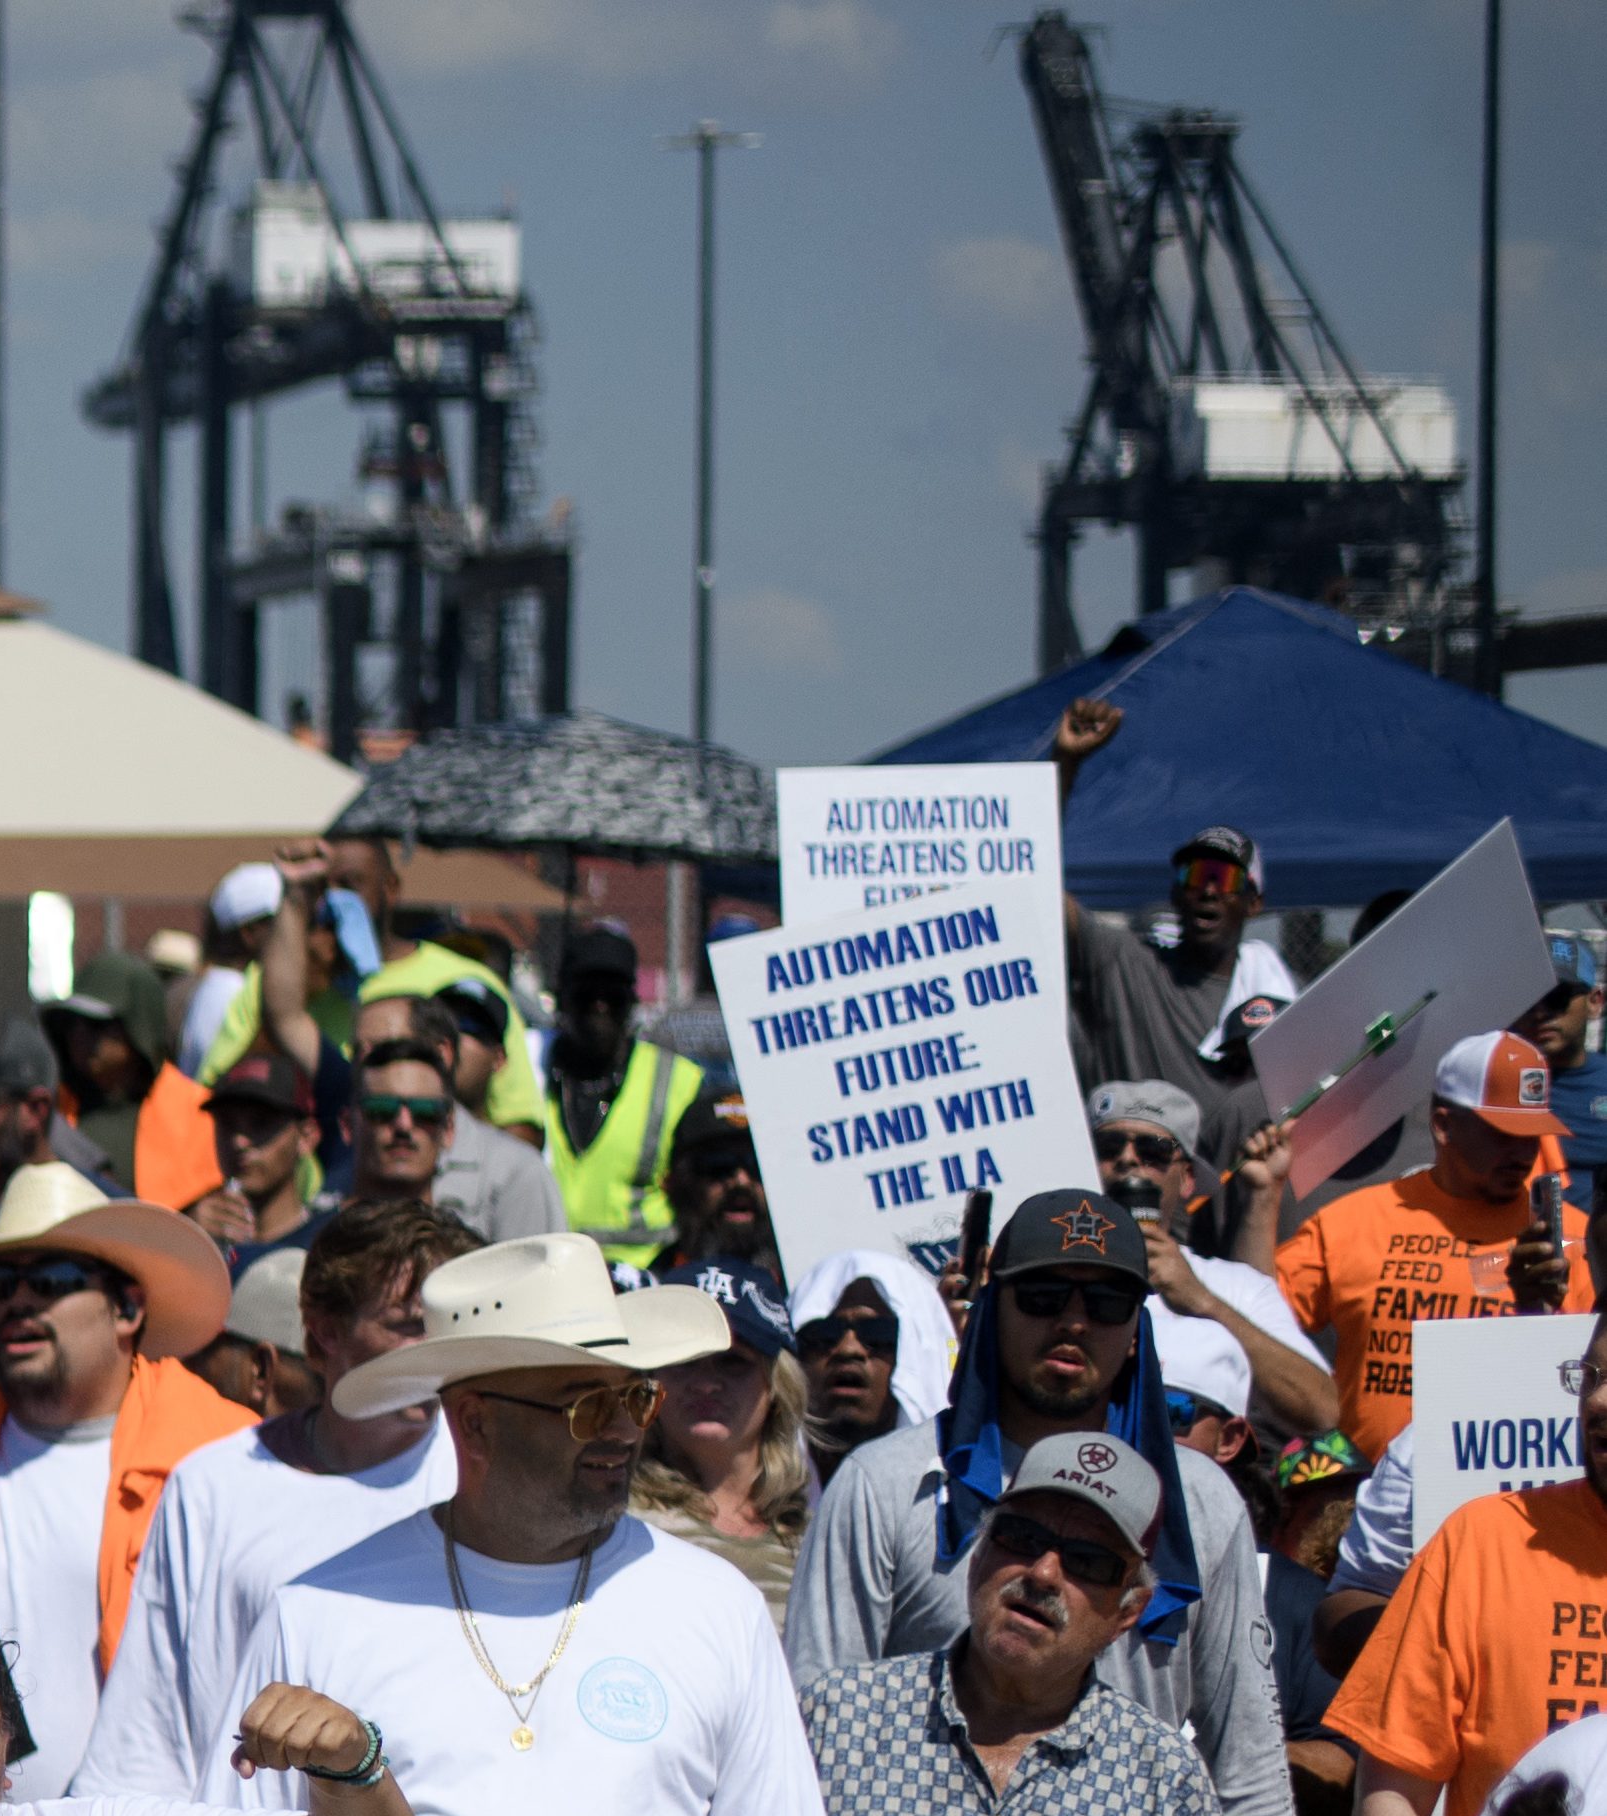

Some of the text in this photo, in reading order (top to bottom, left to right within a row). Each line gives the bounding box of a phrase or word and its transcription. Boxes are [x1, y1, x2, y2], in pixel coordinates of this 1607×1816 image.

[825, 796, 1011, 834] AUTOMATION
[805, 836, 1036, 877] THREATENS OUR
[766, 905, 1001, 995] AUTOMATION
[750, 958, 1039, 1055] THREATENS OUR
[834, 1030, 983, 1098] FUTURE:
[806, 1102, 928, 1163] STAND
[936, 1078, 1035, 1134] WITH
[865, 1147, 1003, 1211] THE ILA
[1388, 1234, 1483, 1259] PEOPLE
[1379, 1260, 1443, 1284] FEED
[1452, 1416, 1585, 1471] WORK
[1052, 1467, 1119, 1501] ARIAT
[1548, 1648, 1607, 1688] FE
